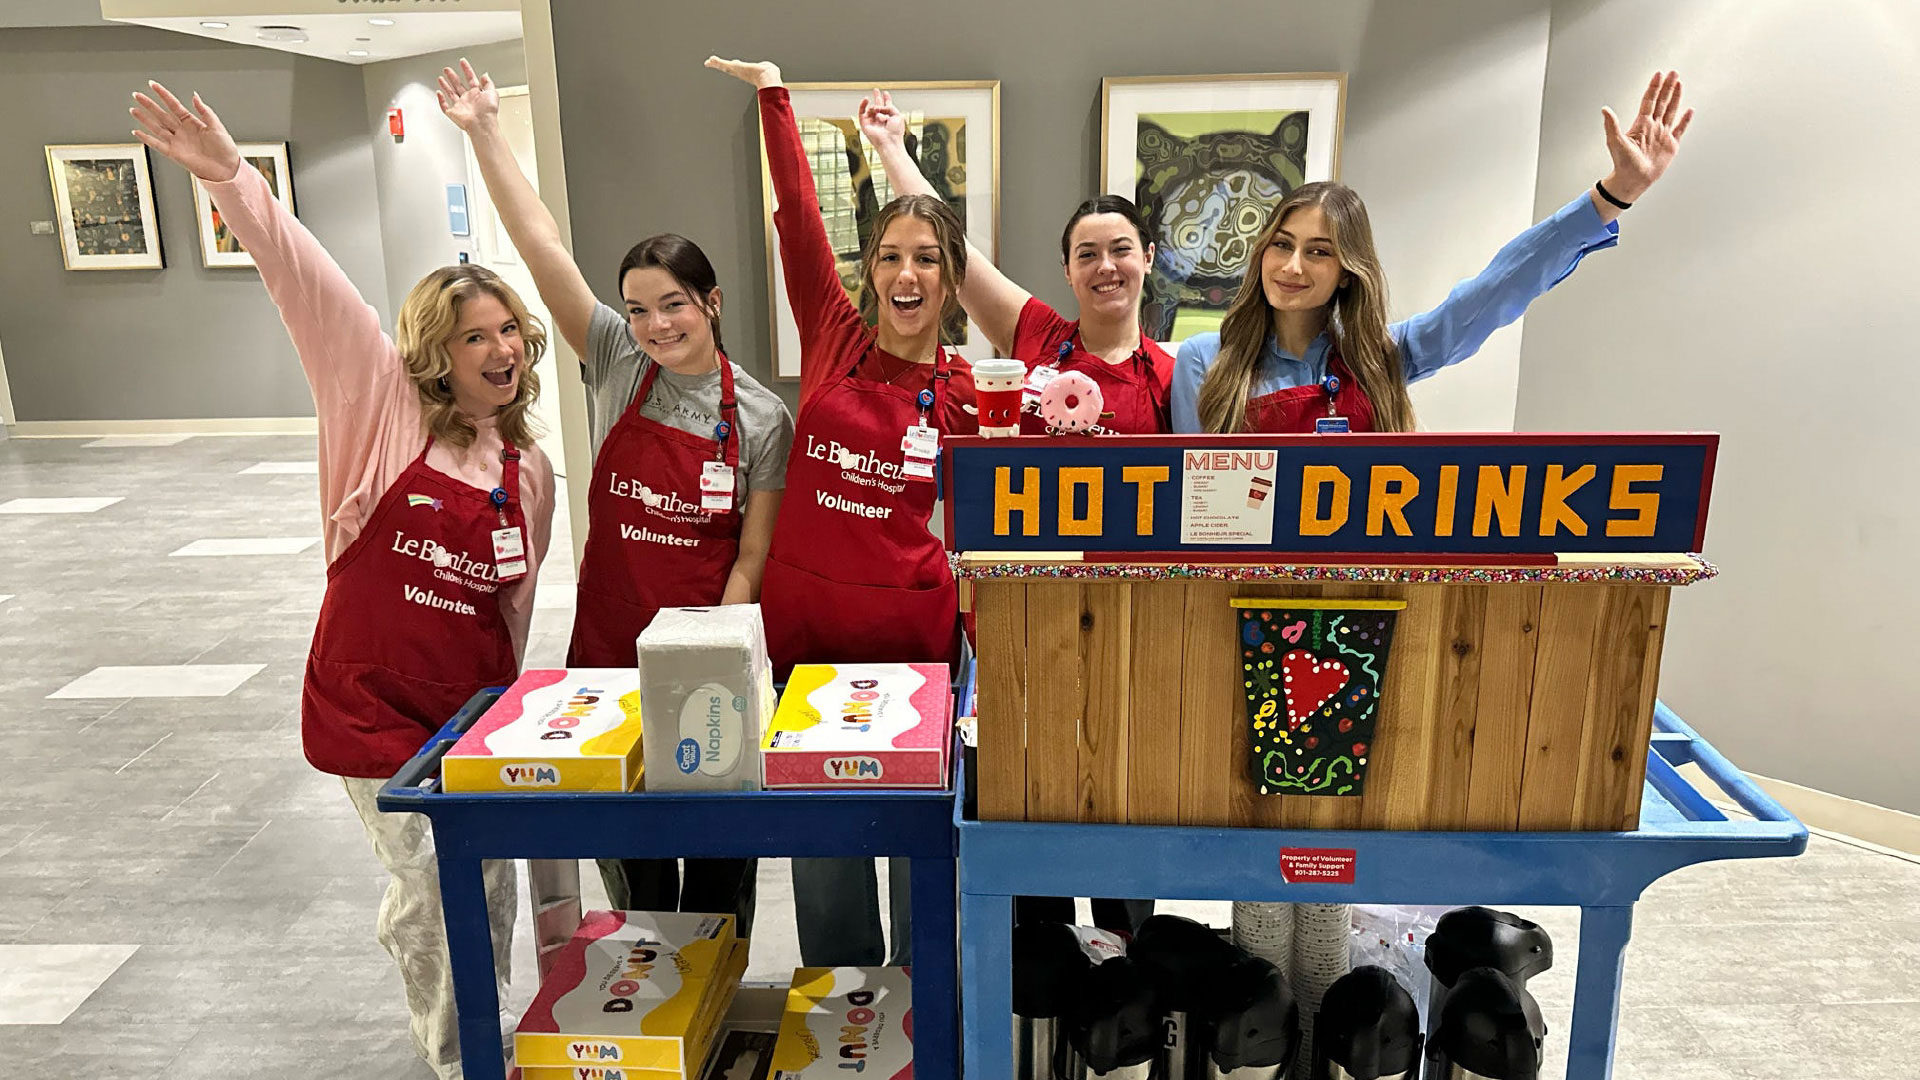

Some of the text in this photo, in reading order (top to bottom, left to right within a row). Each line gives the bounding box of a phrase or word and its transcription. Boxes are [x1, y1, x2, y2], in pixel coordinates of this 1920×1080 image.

[673, 403, 712, 424] ARMY
[806, 434, 909, 482] Le Bonheu
[1185, 452, 1275, 471] MENU
[841, 470, 877, 488] Children's
[608, 472, 712, 517] Le Bonhe
[816, 489, 893, 519] Volunteer
[994, 465, 1664, 538] HOT DRINKS
[620, 523, 701, 548] Volunteer
[391, 530, 500, 583] Le Bonheu
[463, 578, 498, 594] Hospital
[540, 687, 605, 741] DONUT
[841, 679, 880, 733] DONUT
[705, 696, 723, 762] Napkins
[681, 744, 691, 770] Great
[830, 760, 879, 777] YUM
[506, 767, 555, 784] YUM
[1281, 854, 1311, 862] Property
[602, 938, 662, 1013] DONUT
[838, 991, 876, 1073] DONUT
[572, 1044, 618, 1060] YUM
[578, 1068, 622, 1080] YUM
